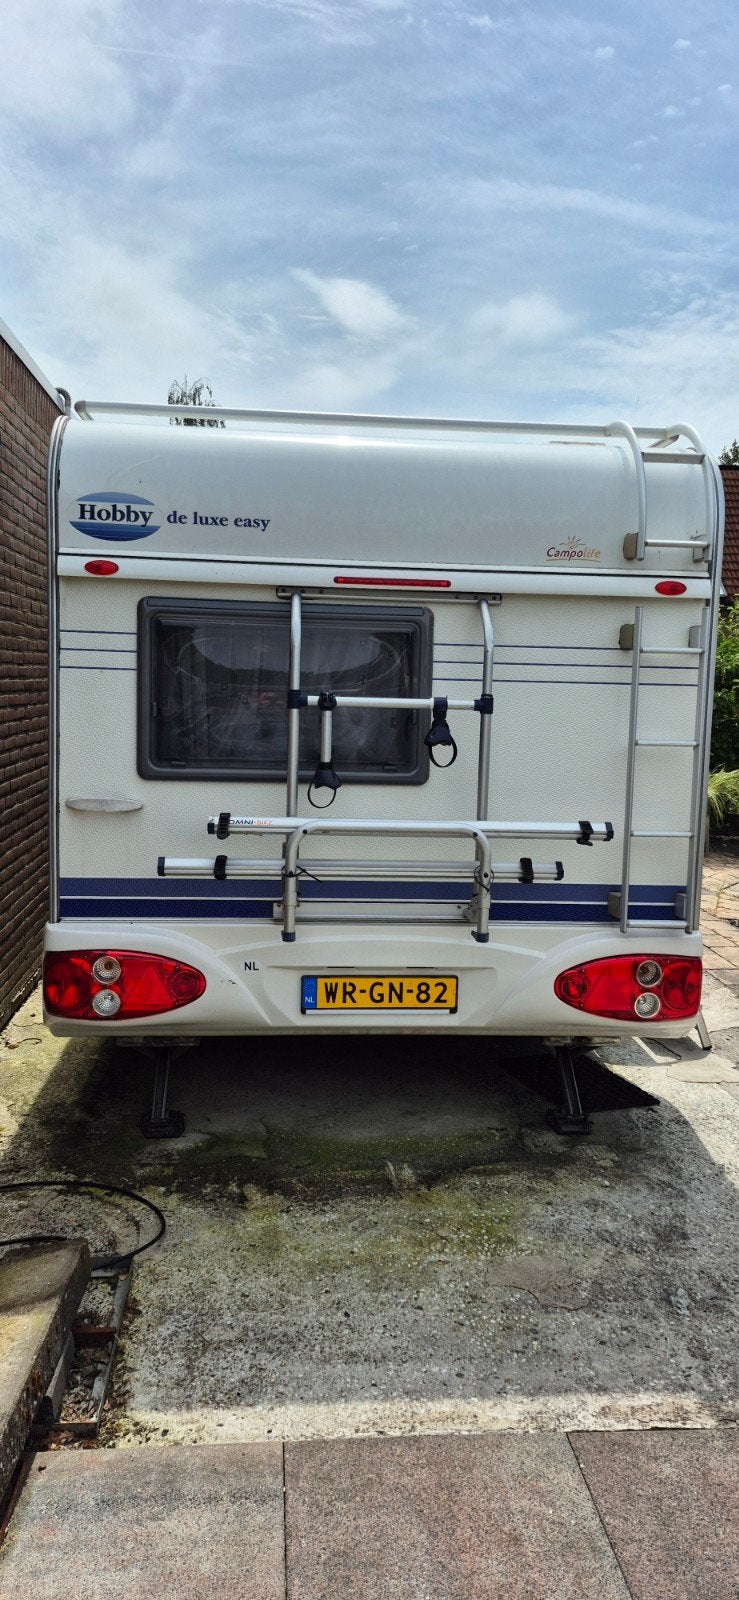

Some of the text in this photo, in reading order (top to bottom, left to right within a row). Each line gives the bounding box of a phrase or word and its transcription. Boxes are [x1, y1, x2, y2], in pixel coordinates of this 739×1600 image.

[78, 503, 271, 532] Hobby de luxe easy
[546, 547, 601, 562] Campolife
[244, 961, 260, 971] NL
[324, 981, 448, 1004] WR-GN-82
